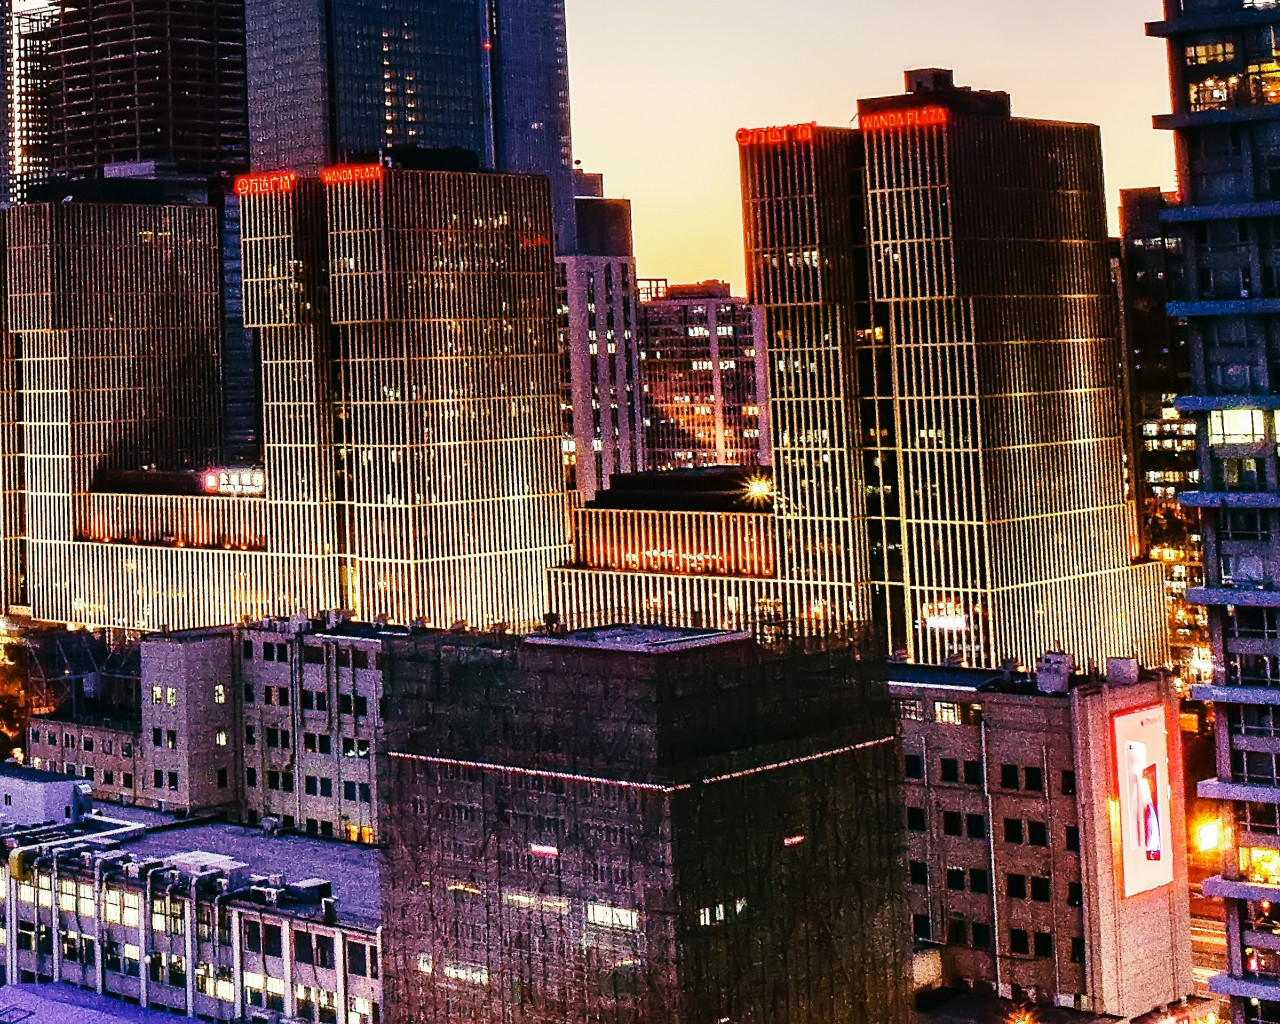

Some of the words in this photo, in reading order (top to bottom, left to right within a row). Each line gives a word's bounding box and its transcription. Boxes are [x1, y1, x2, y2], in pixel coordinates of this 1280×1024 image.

[861, 113, 904, 128] WANDA
[907, 107, 947, 125] PLAZA
[323, 169, 353, 182] WANDA
[354, 166, 381, 179] PLAZA
